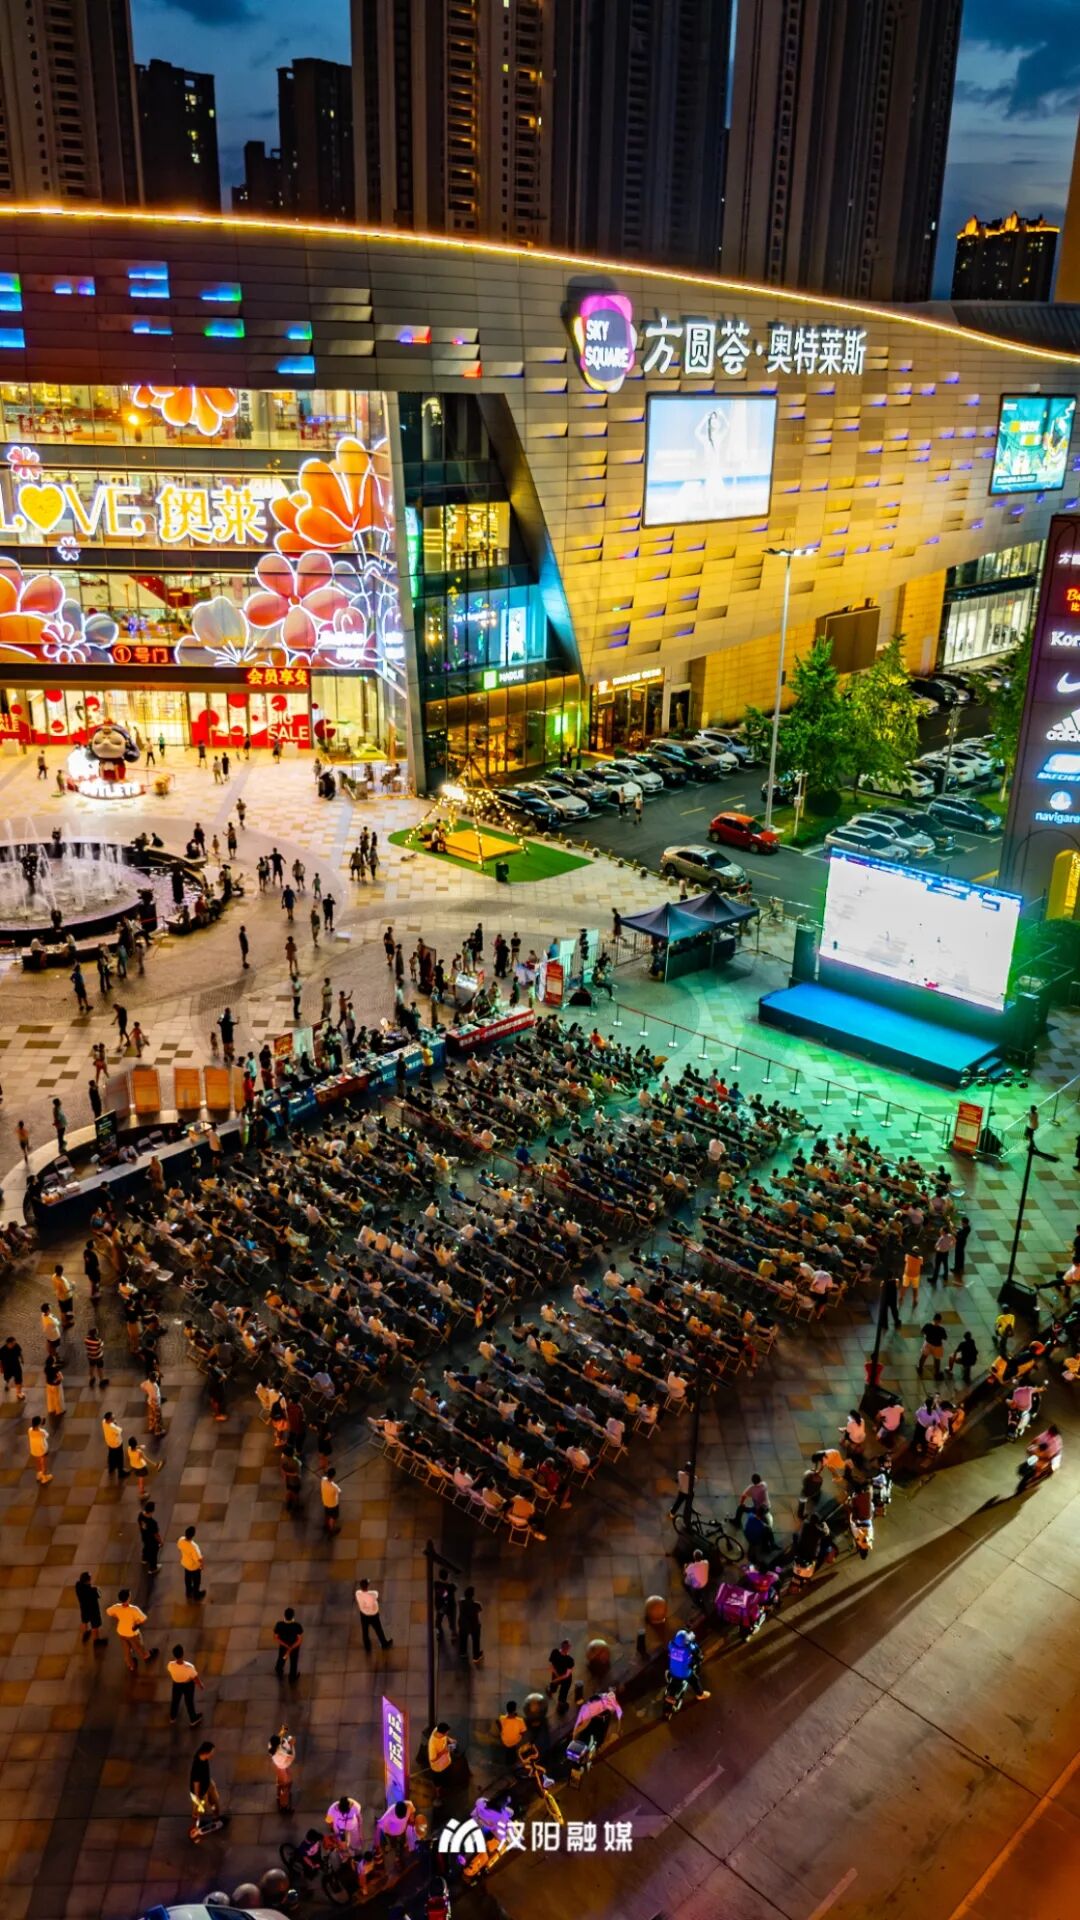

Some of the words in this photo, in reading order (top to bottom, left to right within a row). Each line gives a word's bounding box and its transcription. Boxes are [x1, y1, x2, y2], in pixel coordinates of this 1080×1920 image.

[586, 319, 610, 341] SKY
[584, 345, 630, 371] SQUARE
[643, 317, 867, 375] 方圆荟·奥特莱斯
[267, 724, 310, 741] SALE
